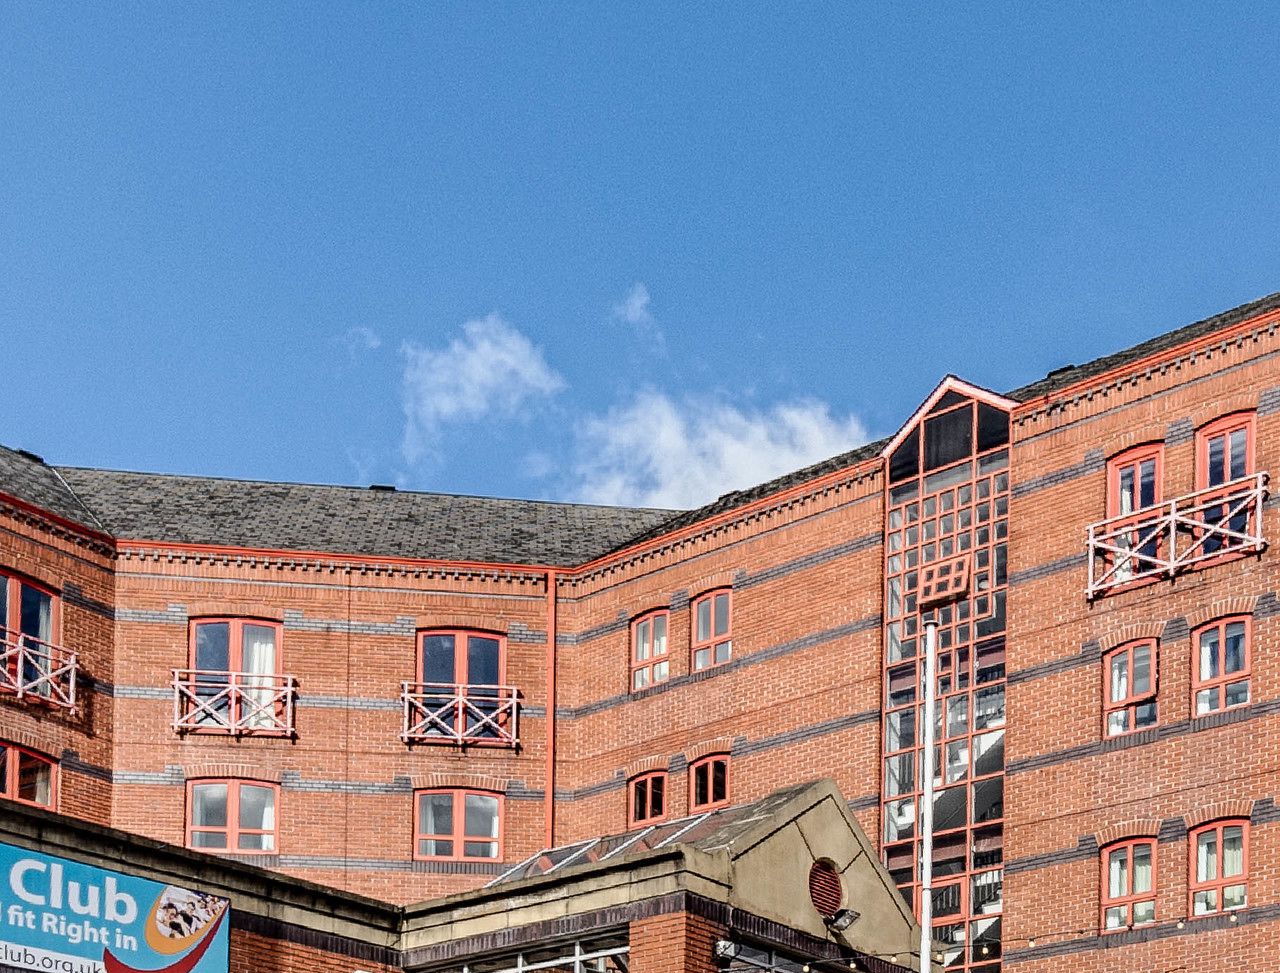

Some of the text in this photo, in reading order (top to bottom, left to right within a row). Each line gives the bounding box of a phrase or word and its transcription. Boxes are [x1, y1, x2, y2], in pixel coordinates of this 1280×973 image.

[9, 858, 139, 925] Club
[7, 904, 36, 930] fit
[41, 911, 109, 945] Right
[115, 930, 139, 951] in
